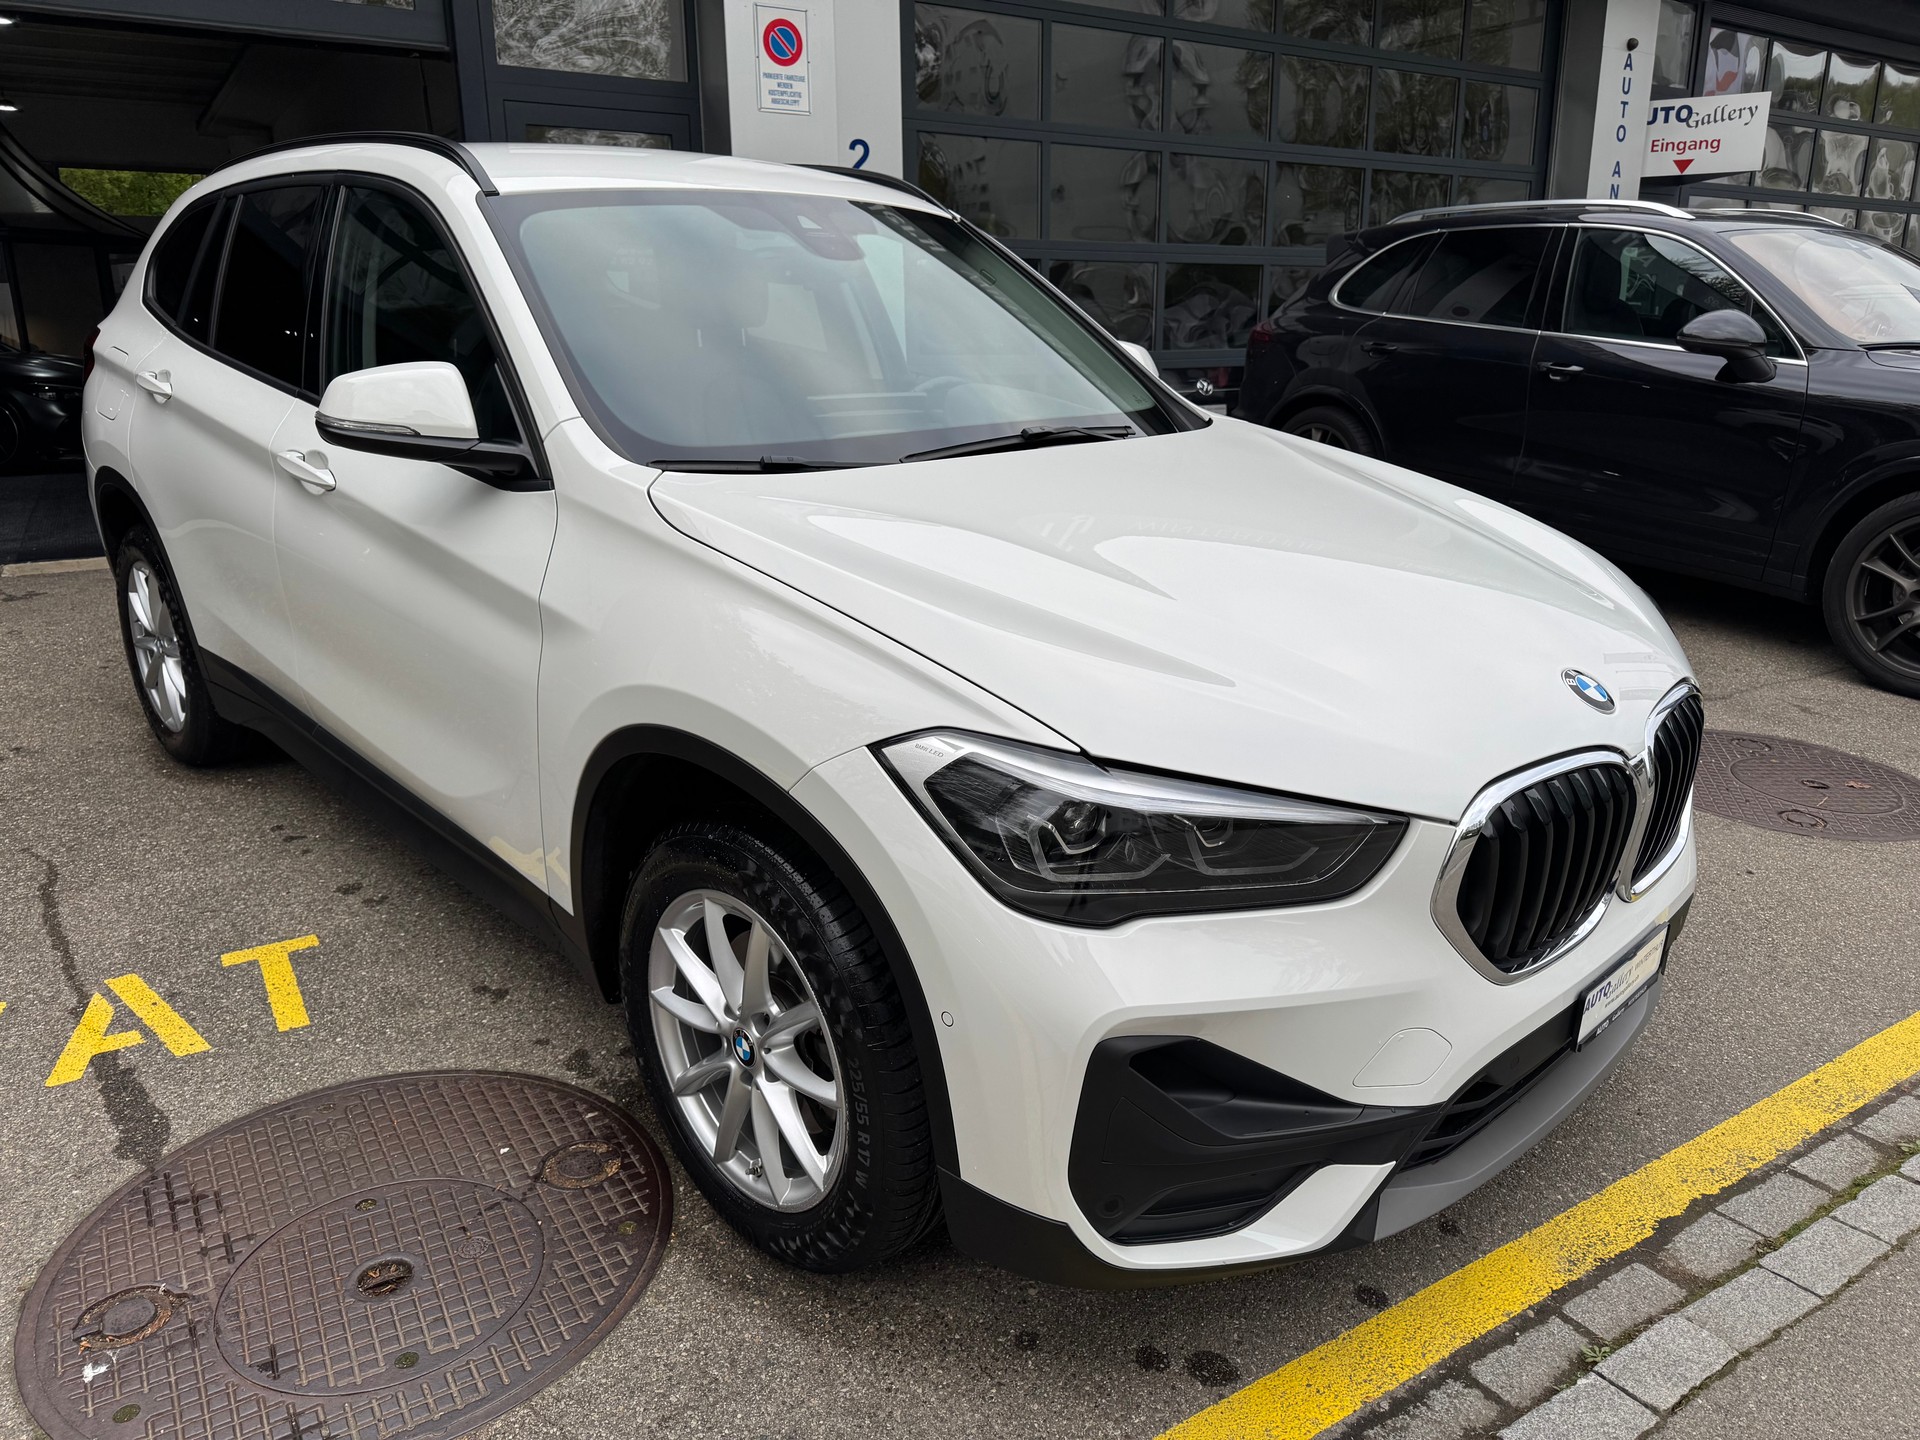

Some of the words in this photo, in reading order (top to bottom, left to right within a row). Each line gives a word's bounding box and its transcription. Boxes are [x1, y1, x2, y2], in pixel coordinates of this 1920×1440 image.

[1616, 53, 1634, 143] AUTO
[1685, 104, 1760, 129] Gallery
[848, 138, 871, 170] 2
[1650, 138, 1722, 156] Eingang
[0, 933, 320, 1088] AT
[847, 1057, 868, 1126] 225/55
